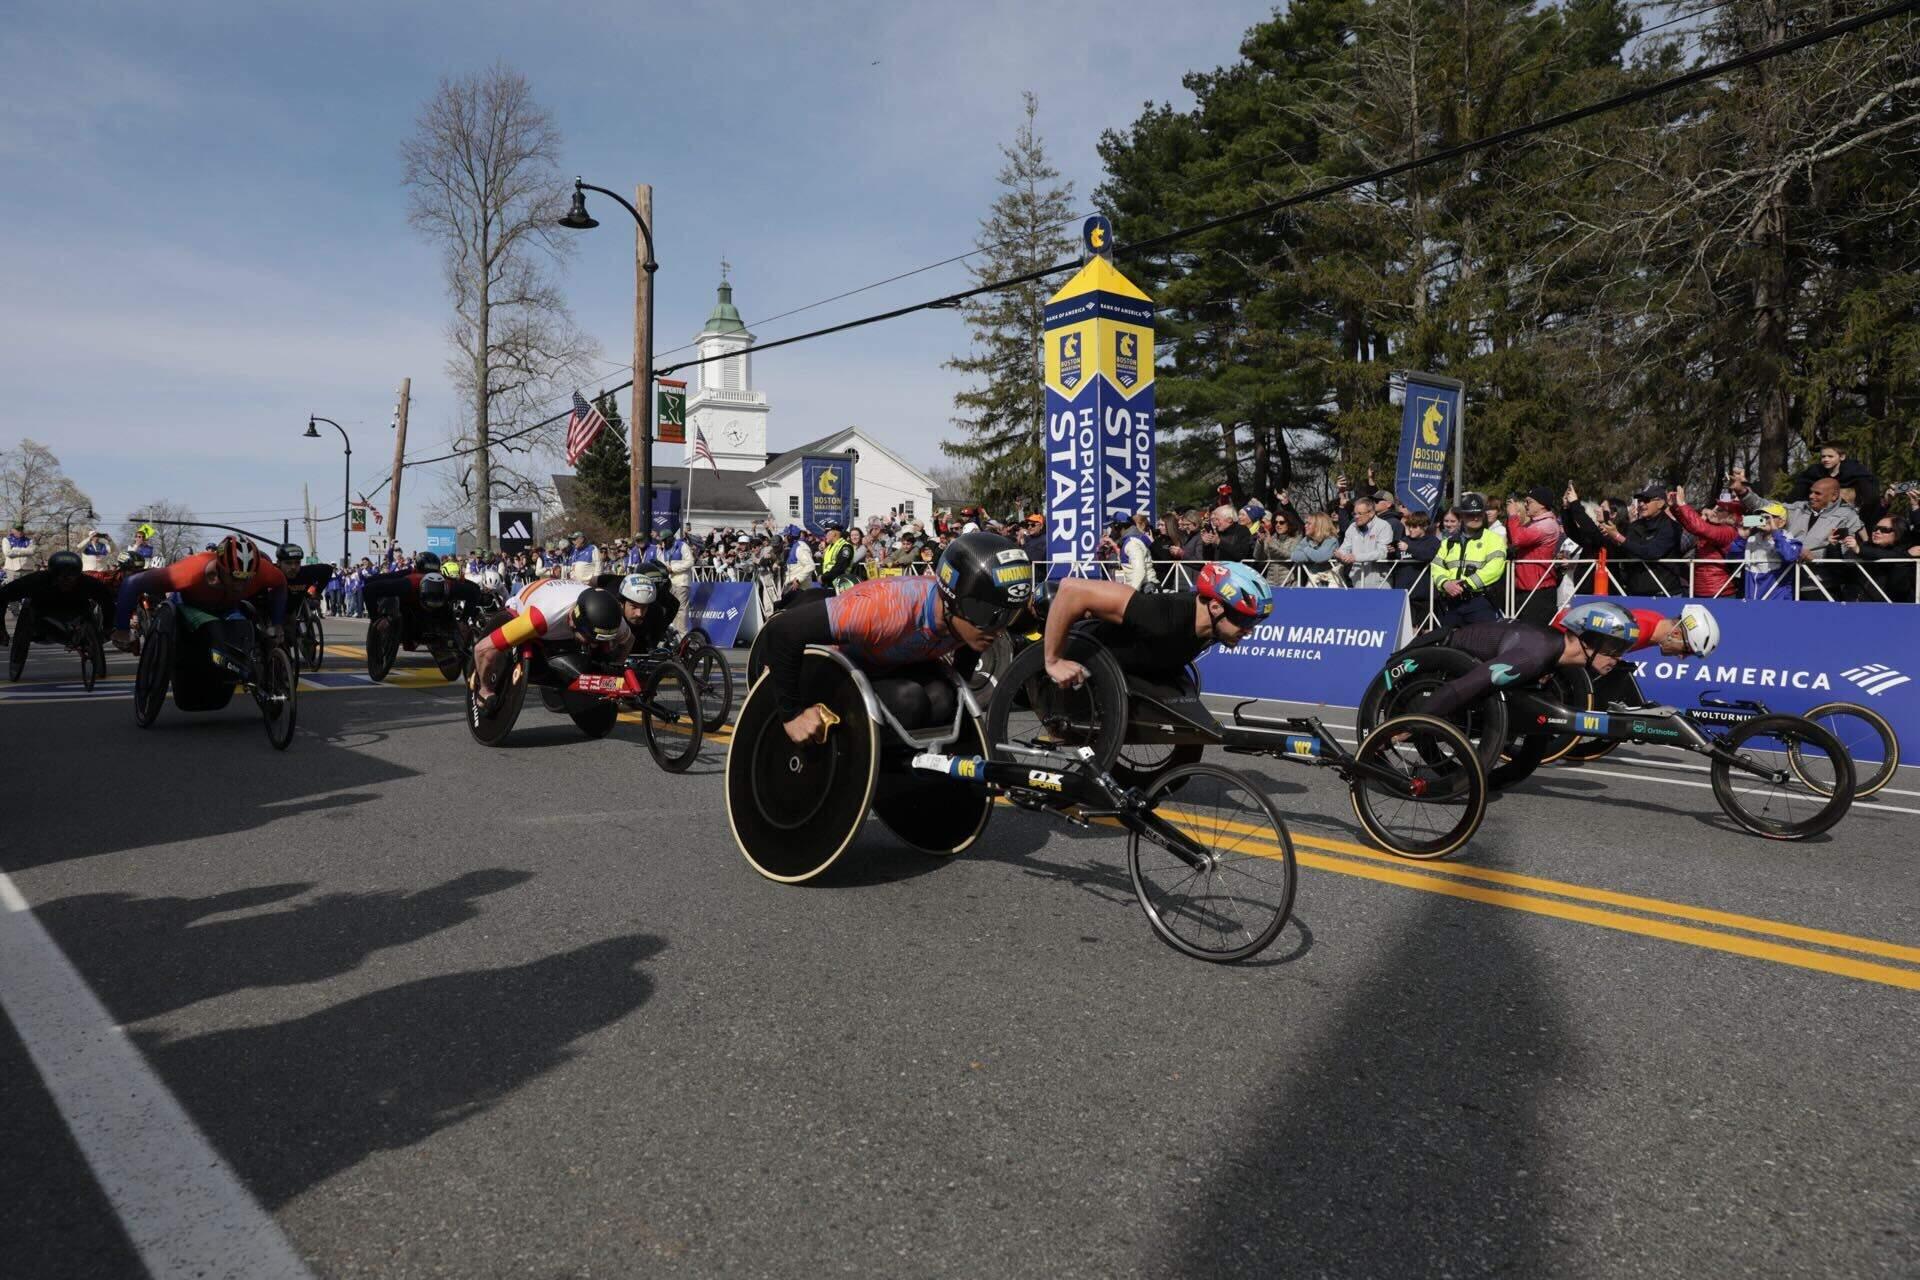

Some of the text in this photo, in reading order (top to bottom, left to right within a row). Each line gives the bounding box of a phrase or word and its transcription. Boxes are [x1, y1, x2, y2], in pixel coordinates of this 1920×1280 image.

[1065, 307, 1086, 317] AMERICA
[1120, 307, 1142, 317] AMERICA
[1414, 448, 1446, 462] BOSTON
[1135, 412, 1151, 518] HOPKIN
[1050, 411, 1077, 571] START
[1079, 407, 1095, 571] HOPKINTON
[815, 496, 841, 505] BOSTON
[1592, 615, 1606, 628] W1
[1287, 626, 1385, 648] MARATHON
[1218, 644, 1322, 660] BANK OF AMERICA
[1655, 661, 1690, 680] OF
[1694, 664, 1831, 691] AMERICA
[1583, 716, 1600, 730] W1
[1647, 727, 1680, 737] Orthotec
[958, 758, 977, 778] W5
[1028, 779, 1063, 792] SPORTS
